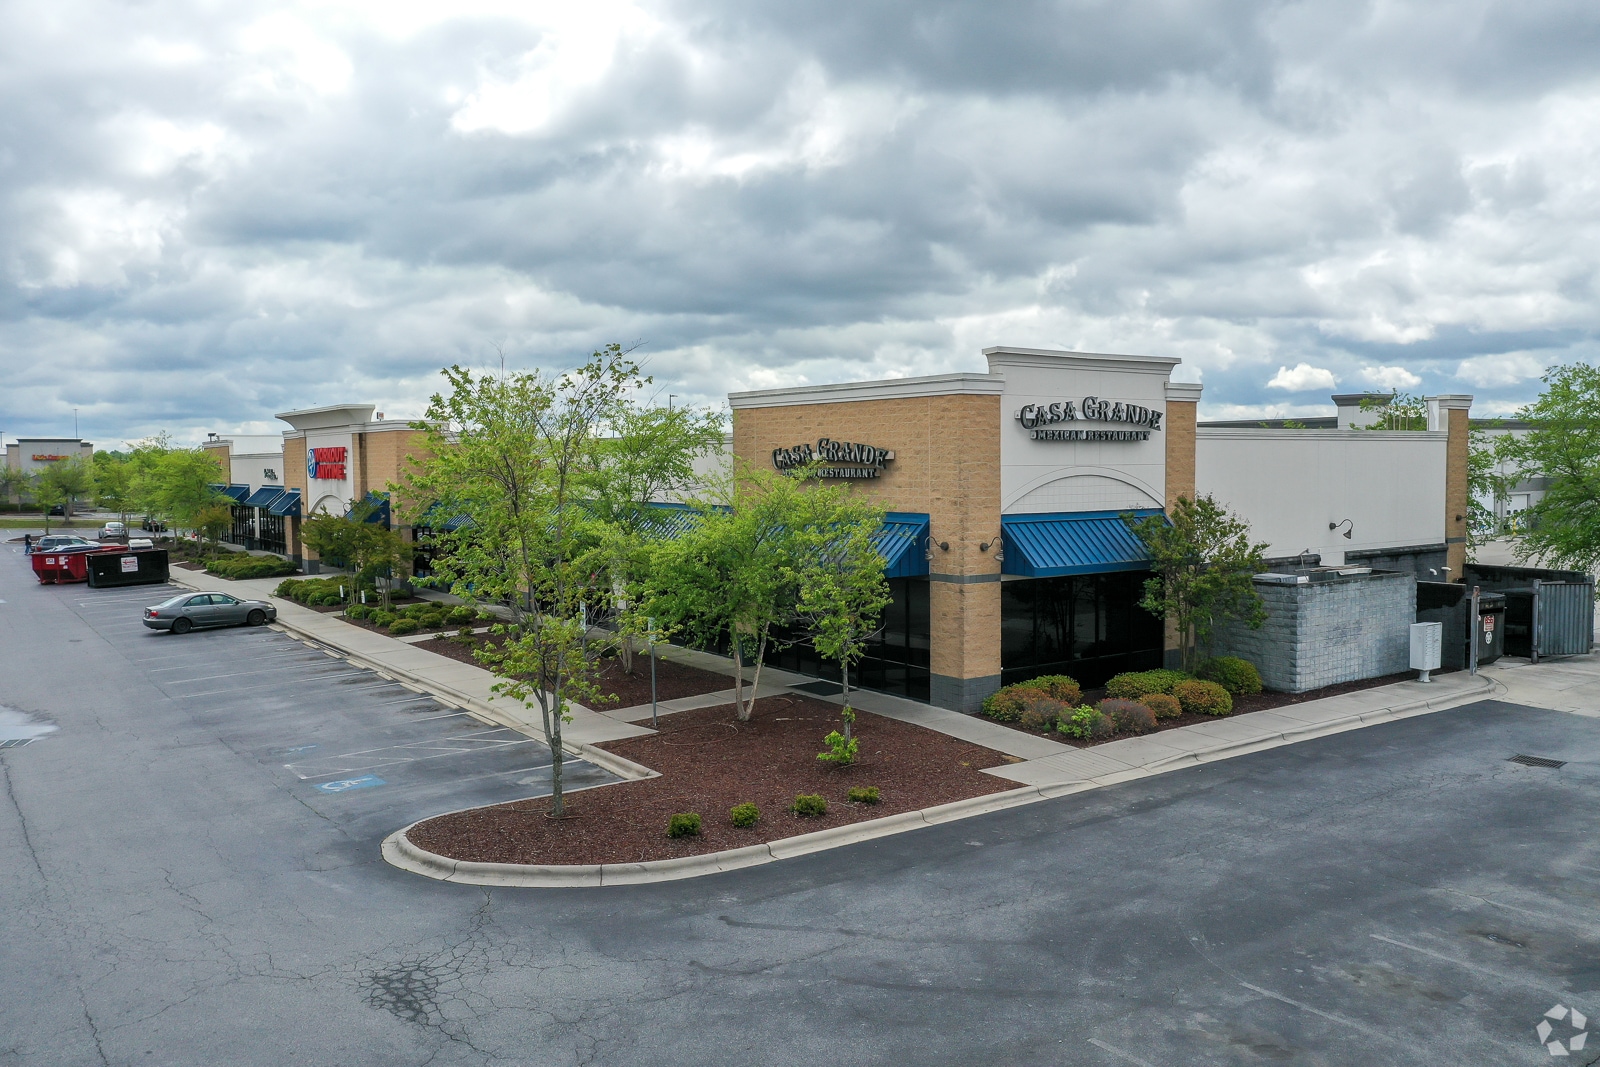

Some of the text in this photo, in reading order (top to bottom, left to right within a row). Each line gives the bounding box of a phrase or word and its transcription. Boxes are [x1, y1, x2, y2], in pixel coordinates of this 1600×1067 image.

[1020, 396, 1163, 431] CASA GRANDE
[1036, 430, 1150, 441] MEXICAN RESTAURANT
[314, 447, 347, 463] WORKOUT
[772, 437, 889, 470] CASA GRANDE
[316, 464, 346, 480] ANYTIME
[818, 468, 876, 478] RESTAURANT
